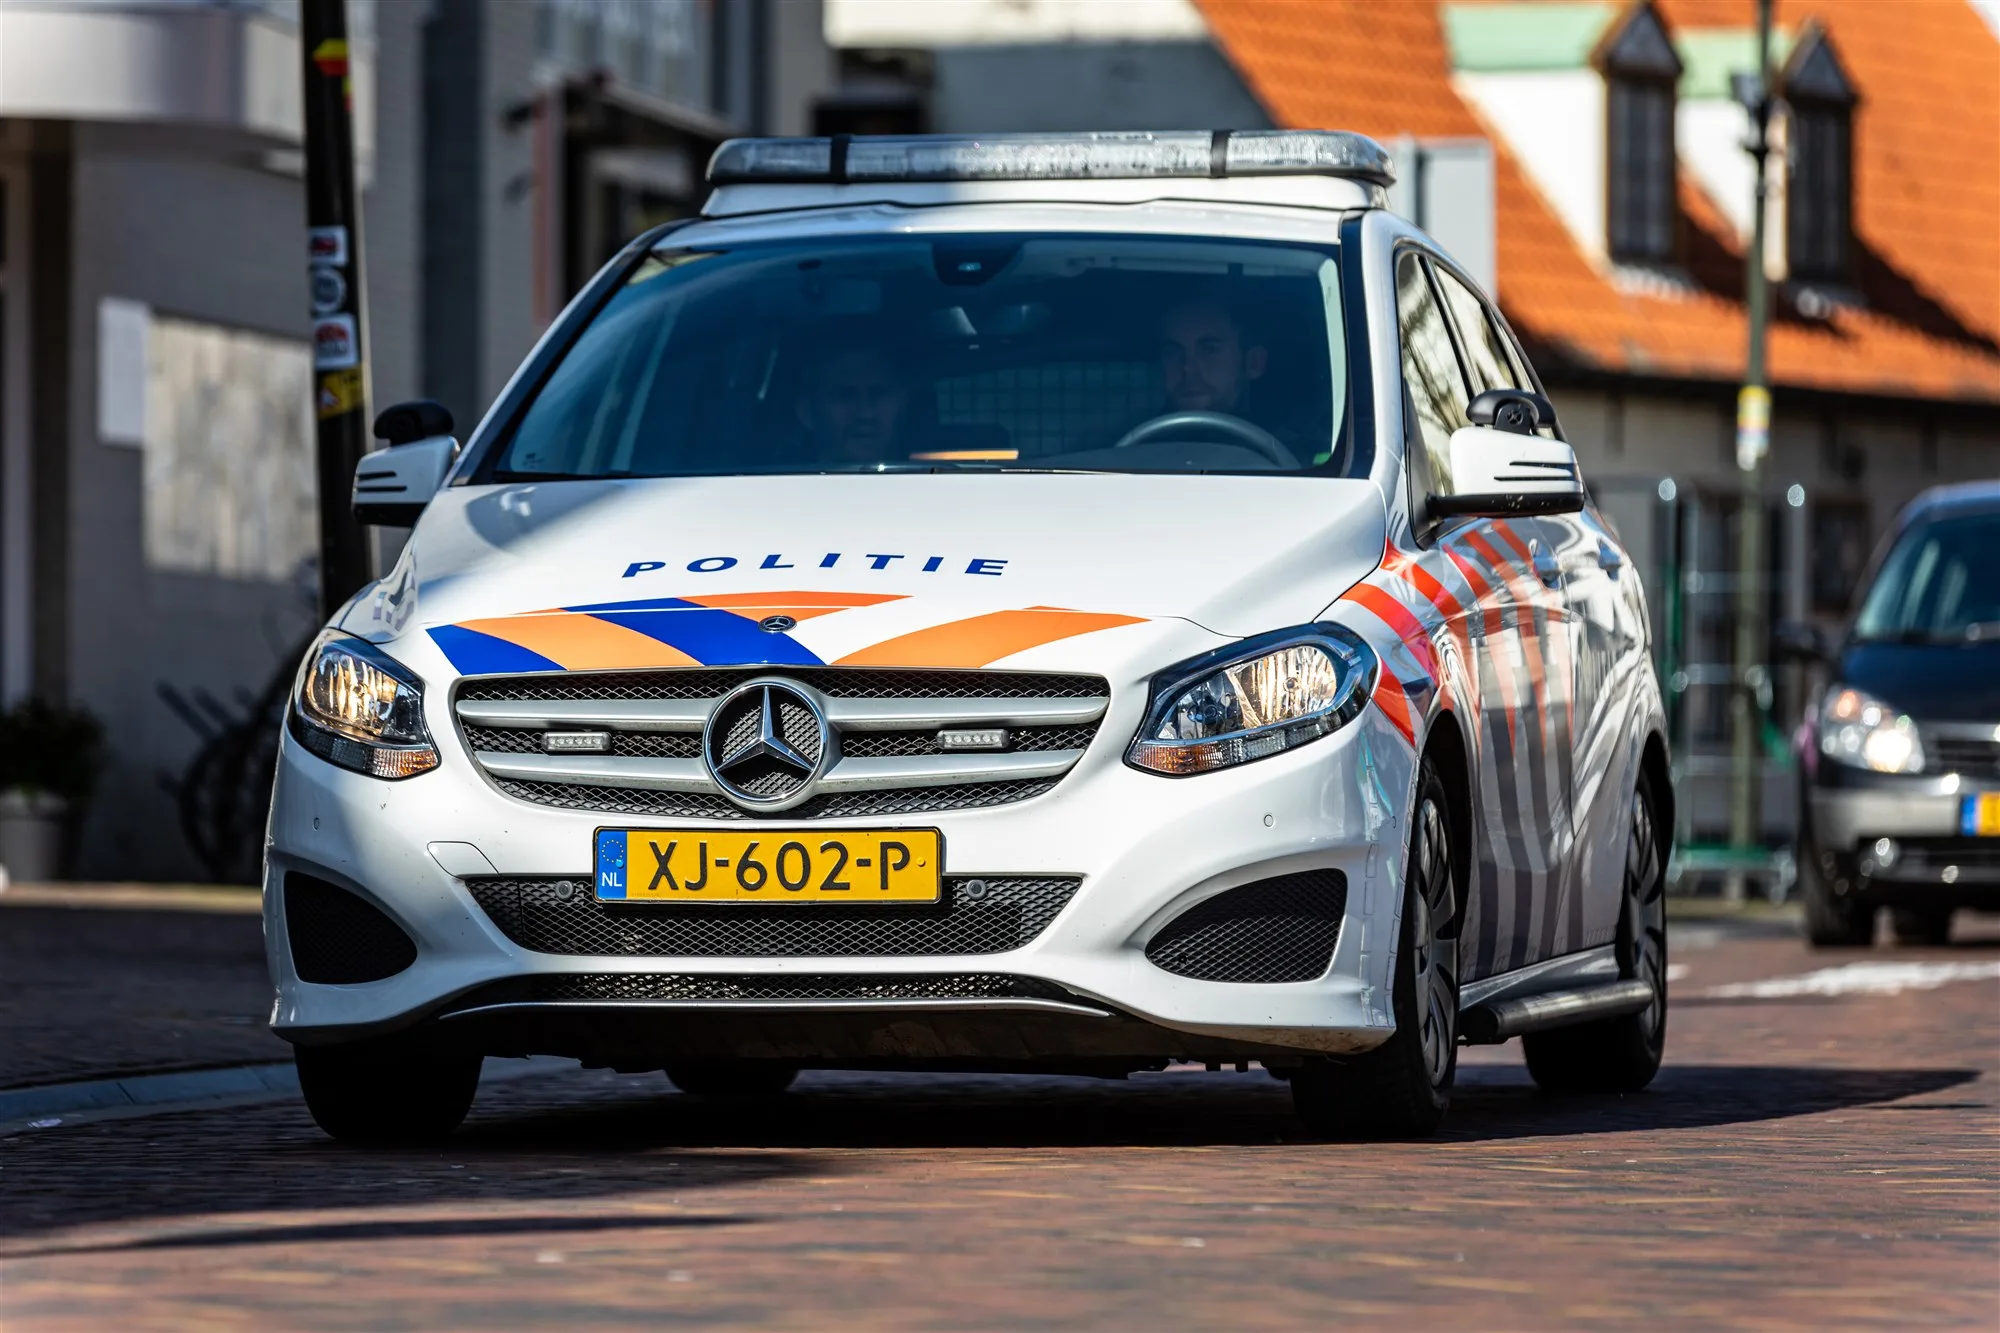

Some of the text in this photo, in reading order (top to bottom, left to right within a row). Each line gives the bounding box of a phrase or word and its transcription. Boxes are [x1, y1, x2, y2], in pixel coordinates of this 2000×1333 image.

[622, 553, 1009, 578] POLITIE
[647, 840, 911, 891] XJ-602-P
[601, 871, 622, 887] NL
